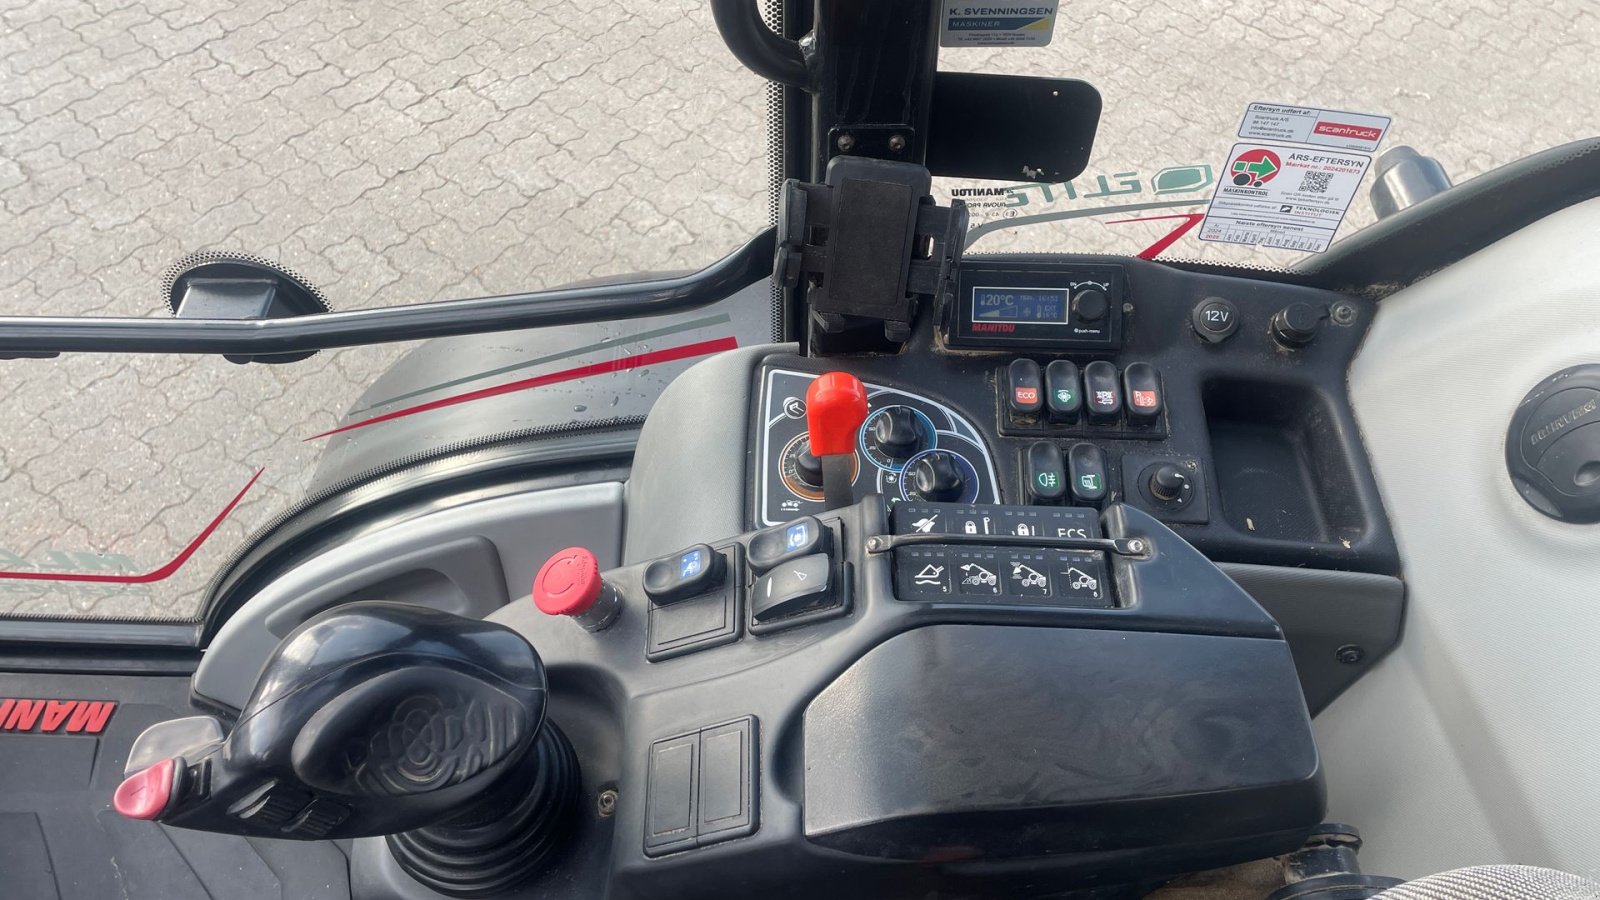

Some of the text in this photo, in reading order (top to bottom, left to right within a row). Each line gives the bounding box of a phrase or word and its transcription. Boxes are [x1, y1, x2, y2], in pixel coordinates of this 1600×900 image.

[949, 7, 1054, 16] K. SVENNINGSEN
[952, 20, 1001, 28] MASKINER
[1253, 105, 1281, 113] Eftersyn
[1318, 124, 1377, 139] scantruck
[1223, 187, 1269, 197] MASKINKONTROL
[1294, 210, 1323, 218] INSTITUT
[1295, 205, 1341, 215] TEKNOLOGISK
[986, 294, 1014, 306] 20°C
[1205, 310, 1230, 323] 12V
[971, 324, 1016, 333] MANITOU
[1017, 391, 1036, 400] ECO
